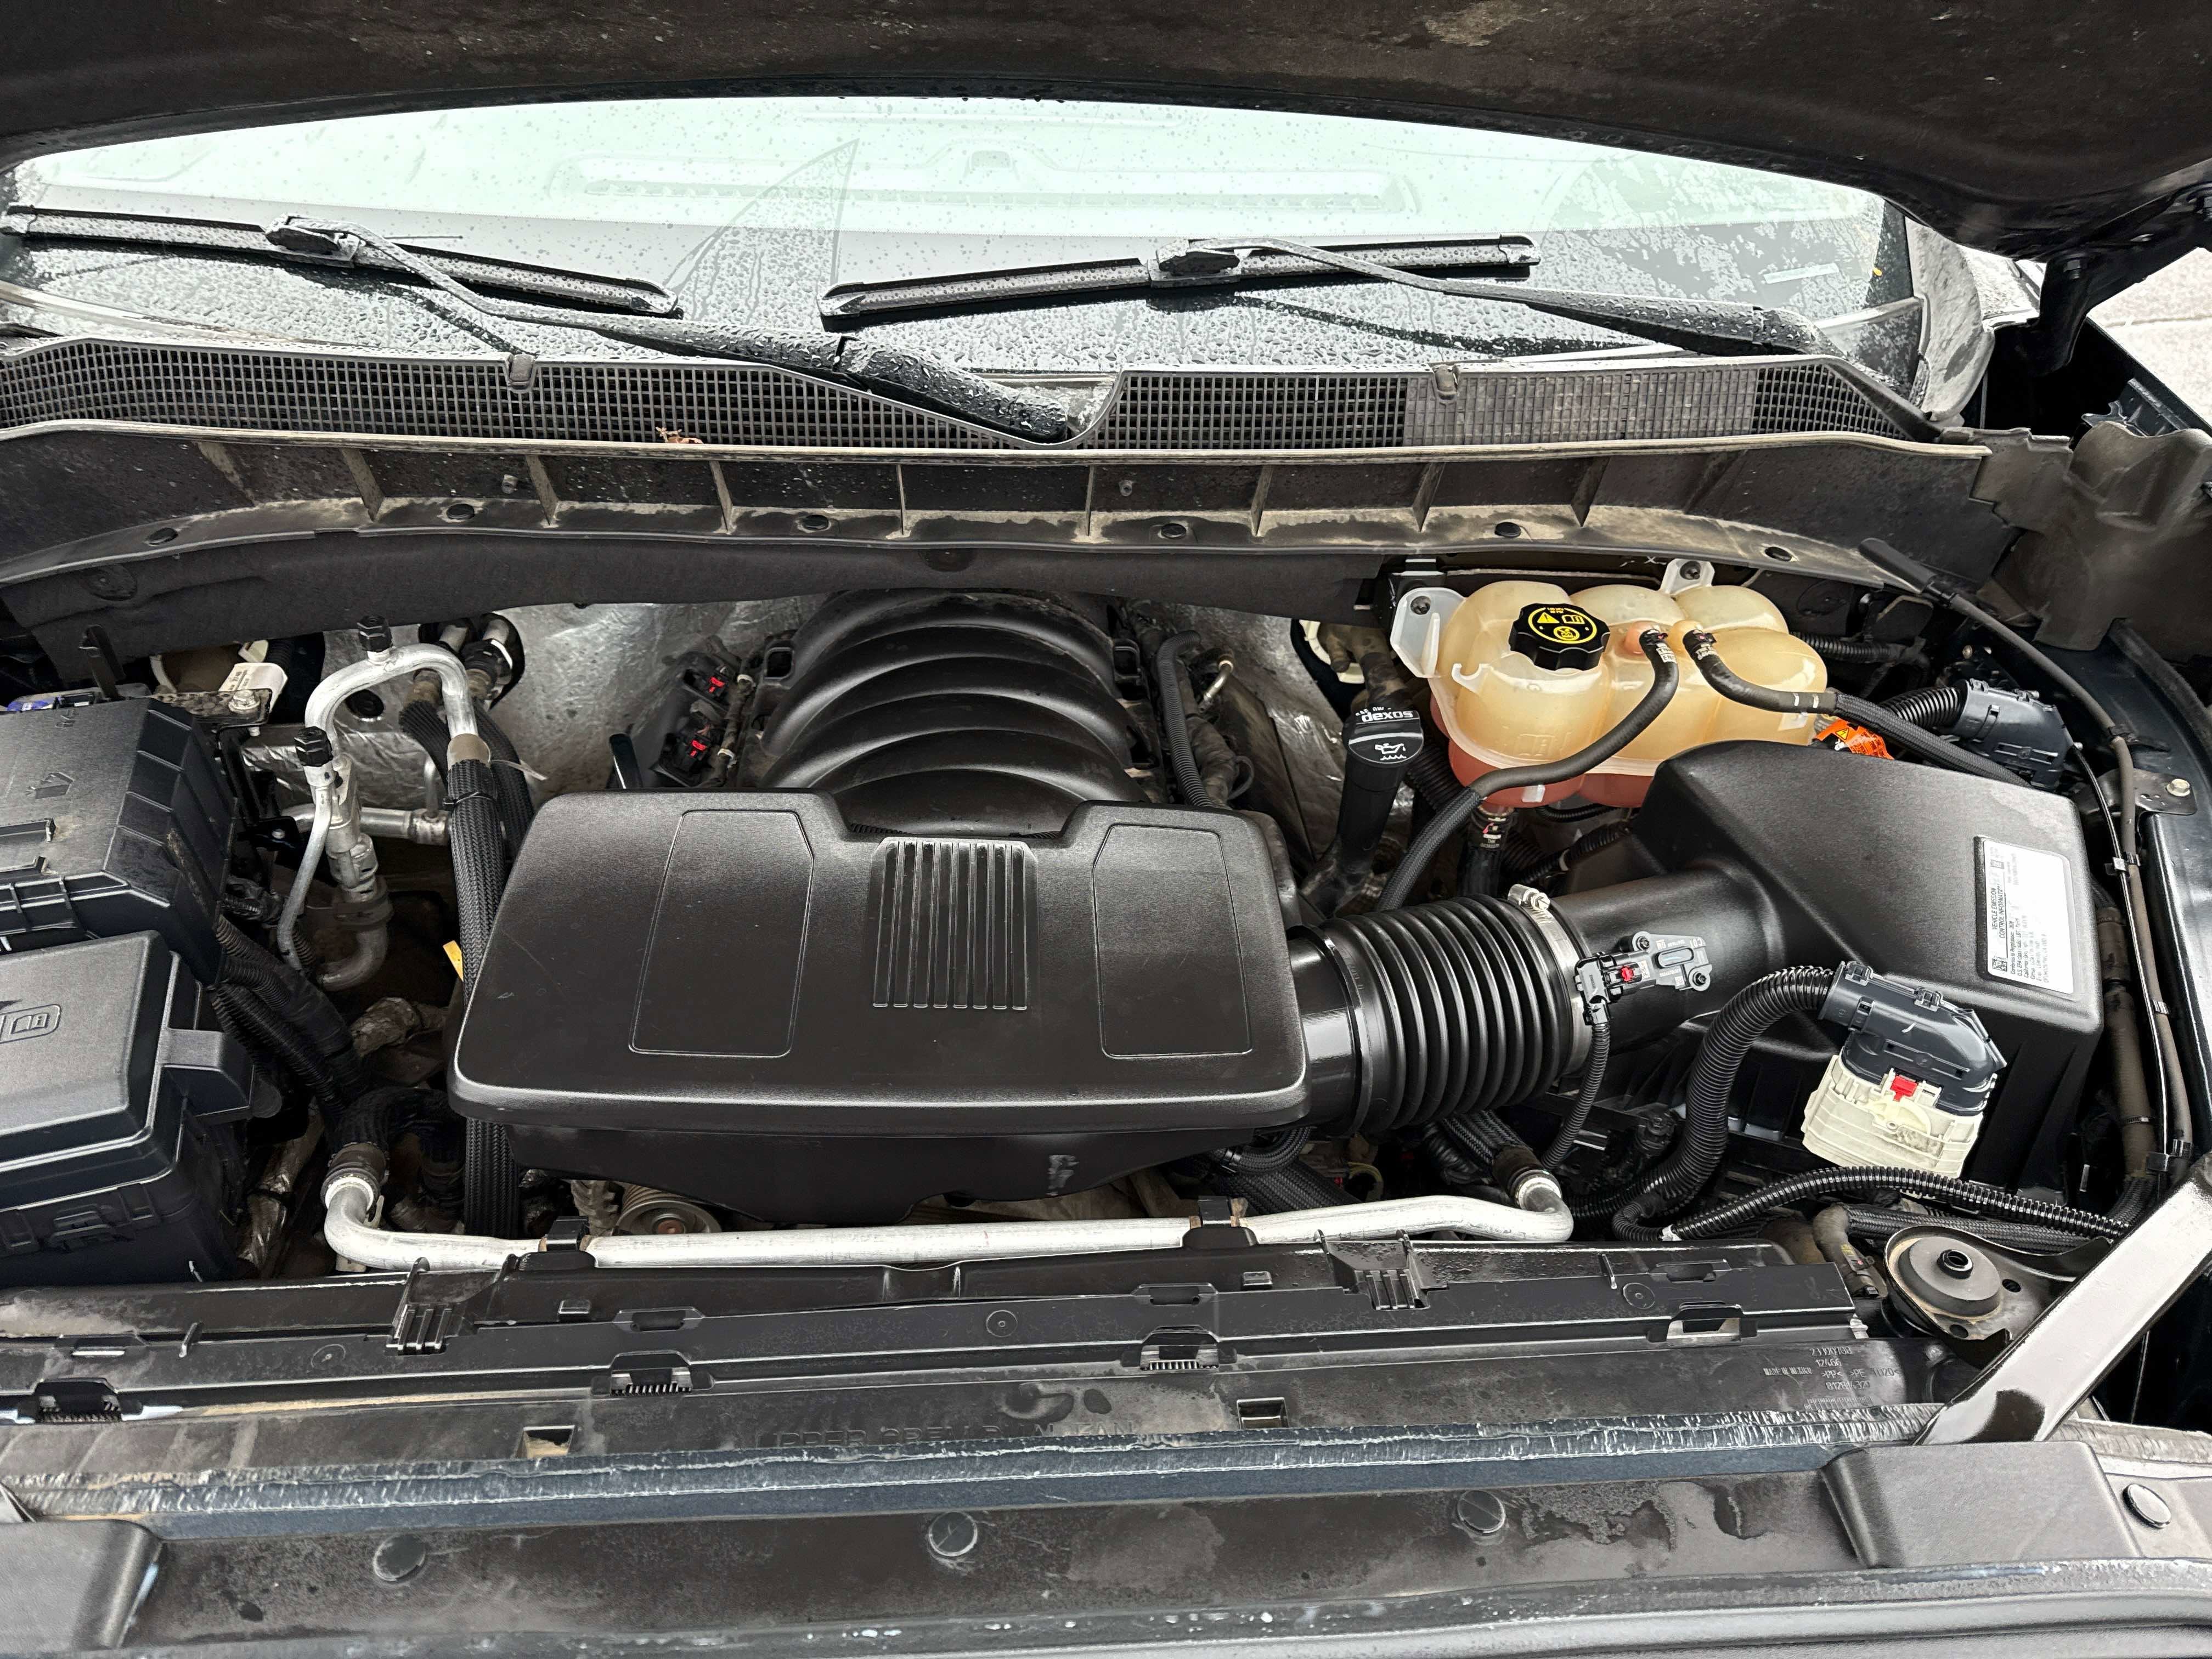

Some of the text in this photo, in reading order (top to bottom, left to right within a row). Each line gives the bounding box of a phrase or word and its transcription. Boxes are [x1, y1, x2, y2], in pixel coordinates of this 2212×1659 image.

[1361, 711, 1413, 722] dexos
[1763, 1366, 1813, 1375] MADE IN MEXICO
